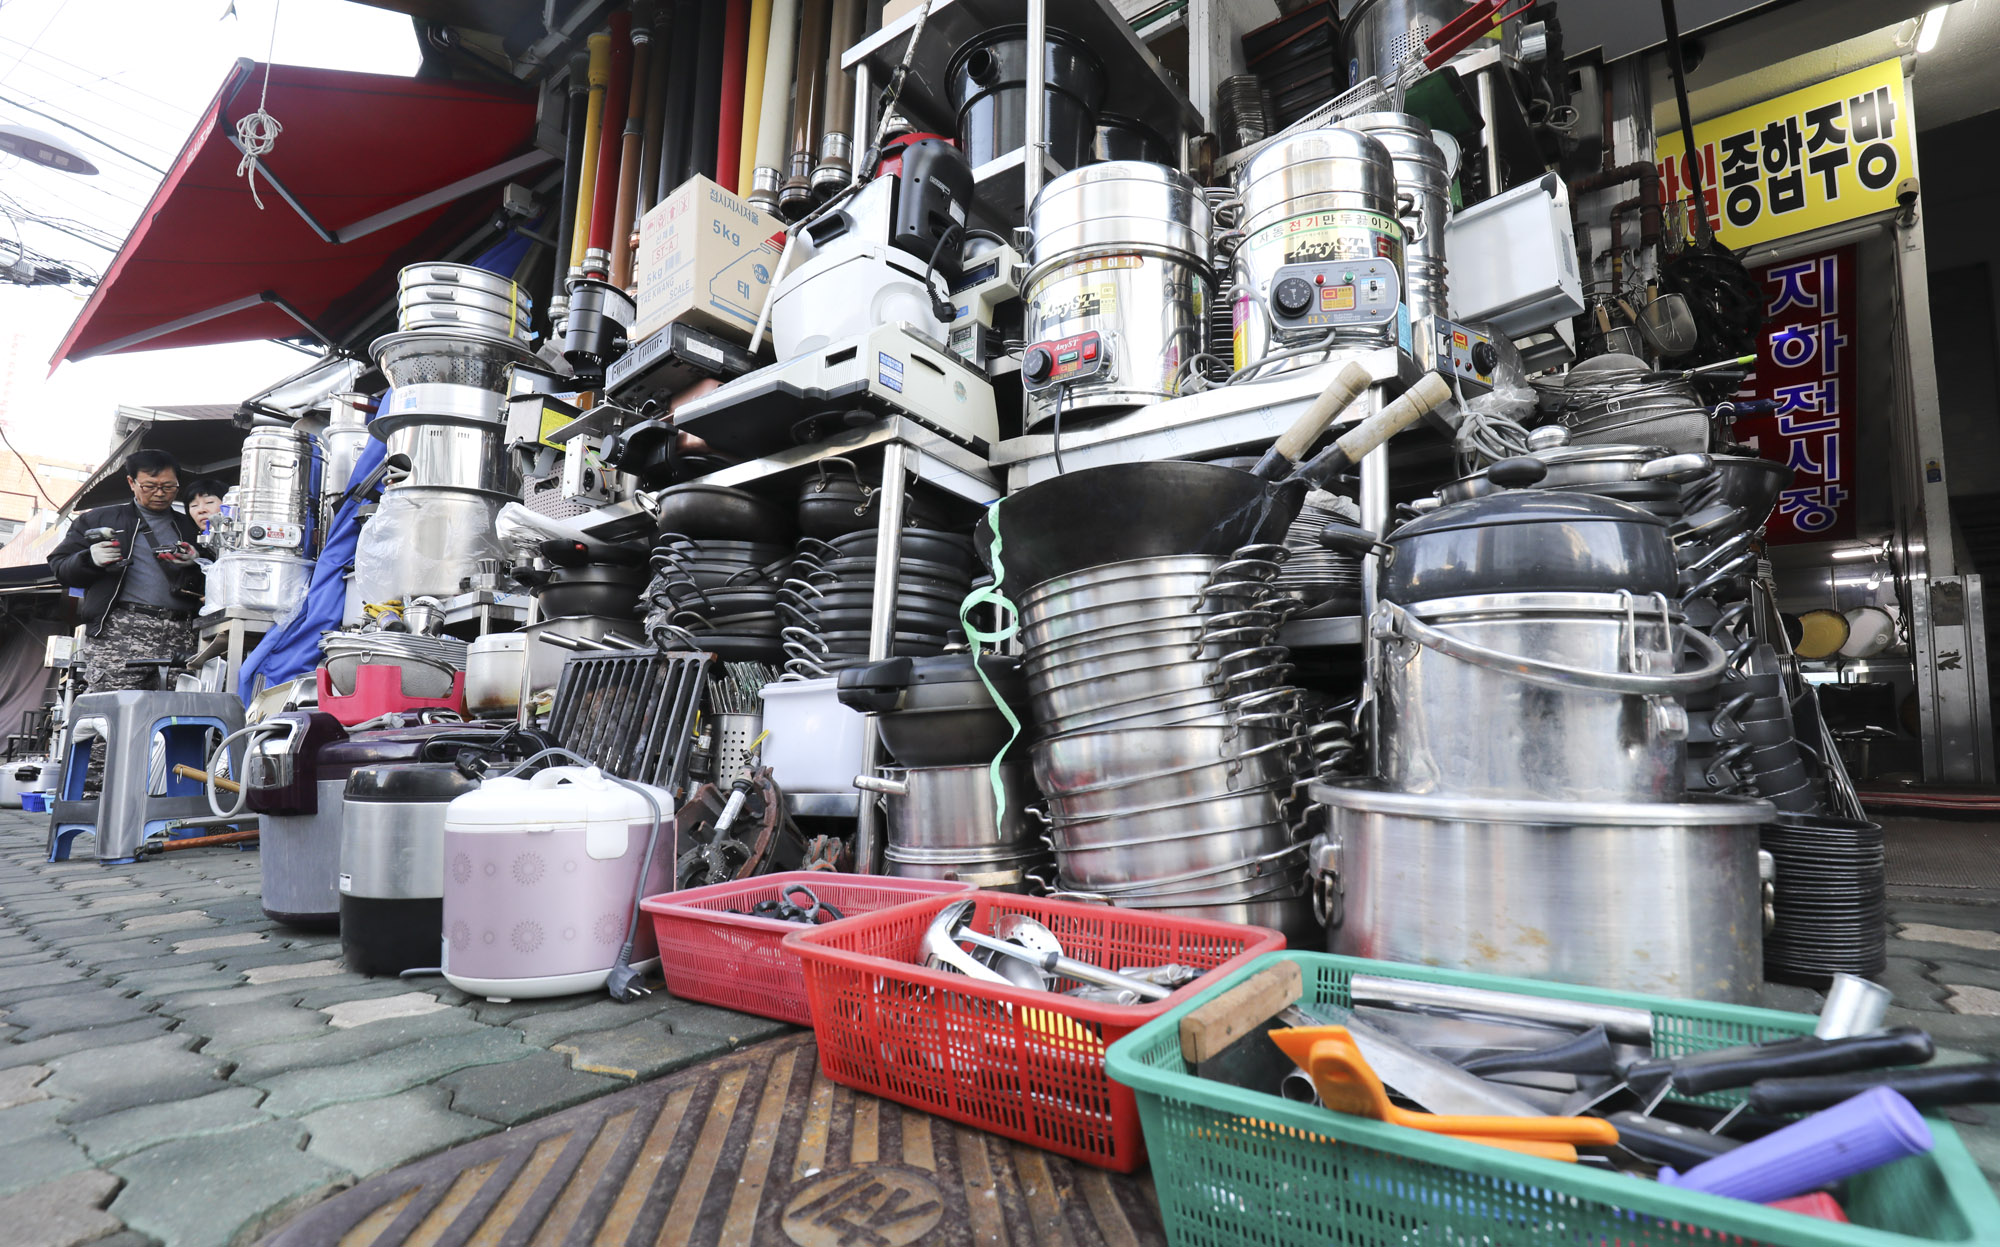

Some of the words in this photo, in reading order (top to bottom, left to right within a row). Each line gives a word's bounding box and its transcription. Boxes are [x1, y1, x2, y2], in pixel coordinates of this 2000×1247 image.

[1720, 85, 1897, 228] 종합주방
[709, 187, 759, 226] 접시지시저울
[712, 218, 741, 247] 5kg
[1288, 236, 1365, 259] AnyST
[646, 267, 663, 286] 5kg
[669, 279, 690, 300] SCALE
[737, 279, 750, 300] 태
[1053, 339, 1080, 352] AnyST
[1766, 254, 1848, 532] 지하전시장
